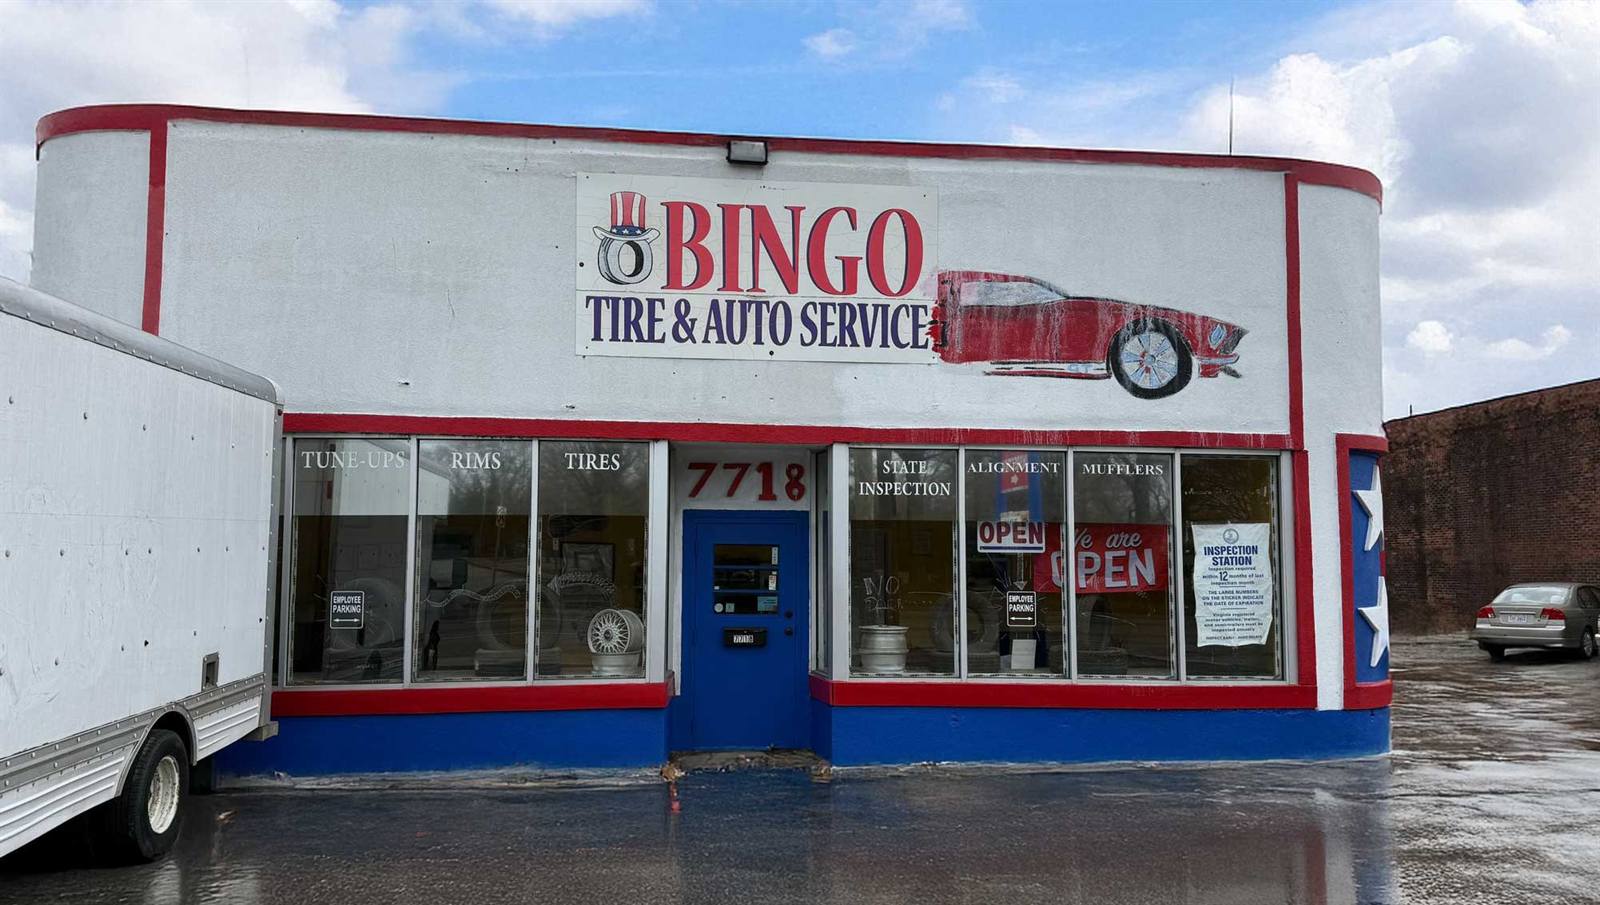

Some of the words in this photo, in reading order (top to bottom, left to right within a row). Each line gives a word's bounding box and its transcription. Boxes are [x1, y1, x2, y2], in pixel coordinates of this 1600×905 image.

[660, 201, 924, 297] BINGO
[585, 295, 666, 343] TIRE
[671, 298, 698, 344] &
[702, 299, 793, 346] AUTO
[800, 301, 929, 350] SERVICE
[301, 451, 406, 469] TUNE-UPS
[450, 452, 502, 470] RIMS
[564, 453, 621, 471] TIRES
[882, 460, 928, 475] STATE
[967, 462, 1061, 474] ALIGNMENT
[1082, 463, 1164, 476] MUFFLERS
[687, 462, 807, 502] 7718
[858, 481, 952, 497] INSPECTION
[979, 521, 1044, 545] OPEN
[1105, 531, 1143, 549] are
[1203, 545, 1258, 556] INSPECTION
[1212, 556, 1252, 566] STATION
[1219, 571, 1228, 581] 12
[333, 595, 362, 604] EMPLOYEE
[1008, 595, 1034, 603] EMPLOYEE
[332, 604, 362, 613] PARKING
[1008, 604, 1034, 612] PARKING
[733, 634, 754, 643] 7718
